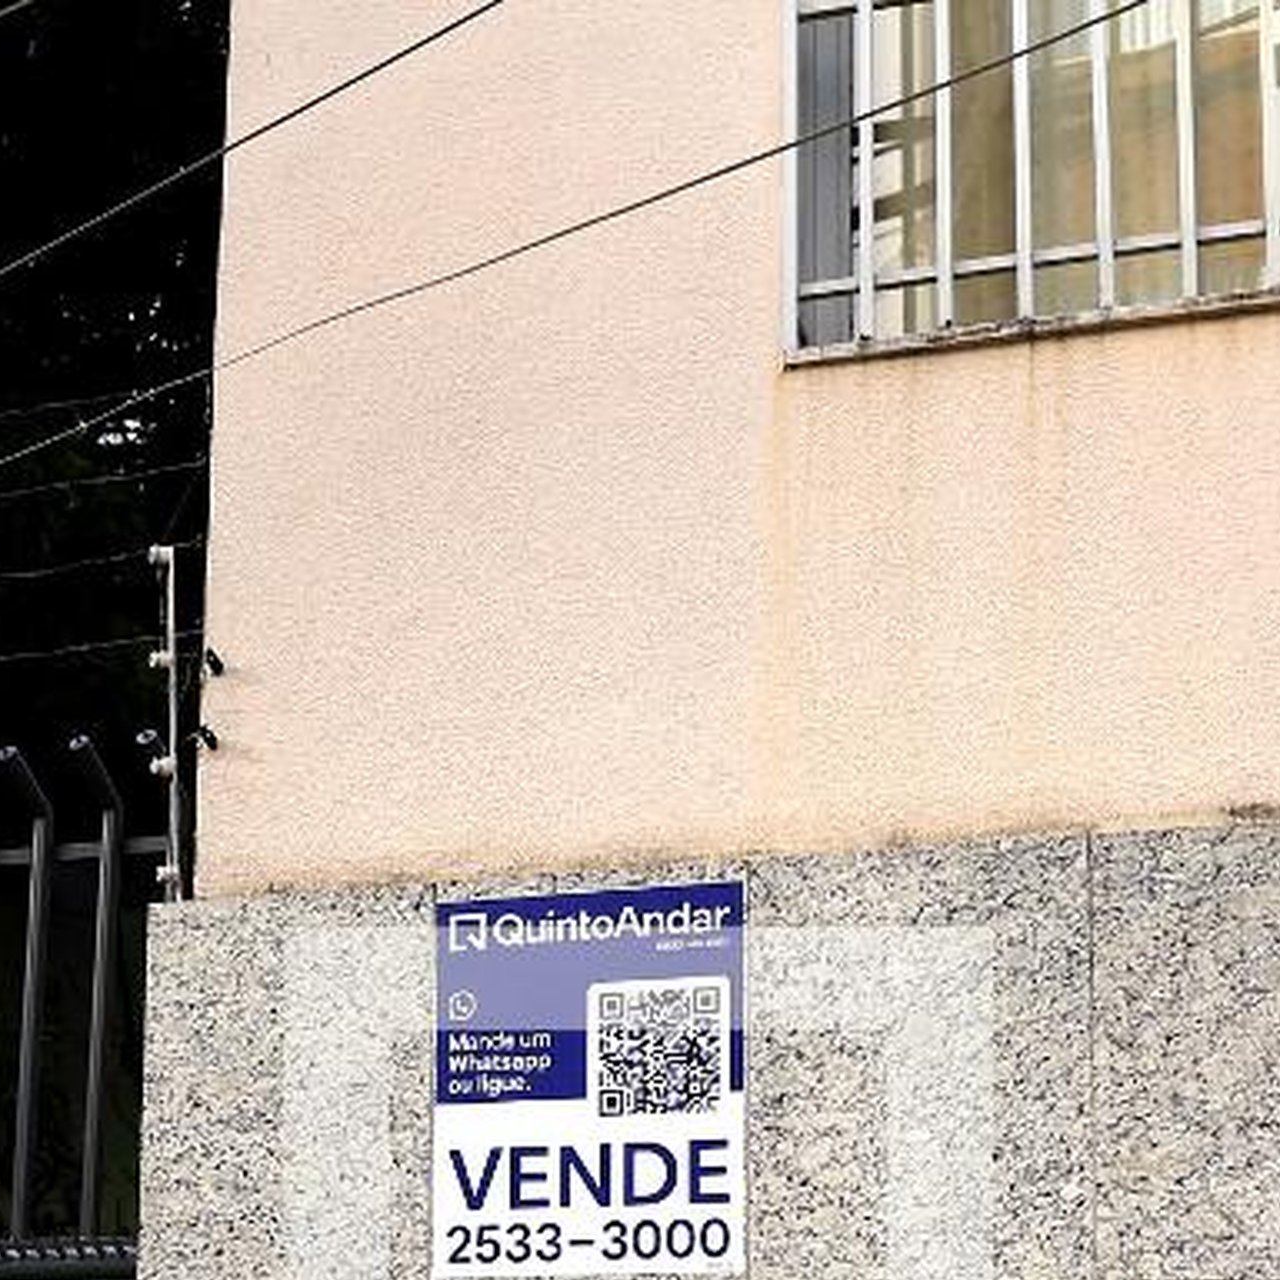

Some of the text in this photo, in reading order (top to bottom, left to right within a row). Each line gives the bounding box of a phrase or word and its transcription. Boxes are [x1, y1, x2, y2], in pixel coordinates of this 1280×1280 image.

[493, 902, 730, 946] QuintoAndar
[448, 1031, 551, 1051] Mande um
[448, 1077, 473, 1094] ou
[449, 1139, 730, 1211] VENDE
[446, 1218, 730, 1264] 2533-3000
